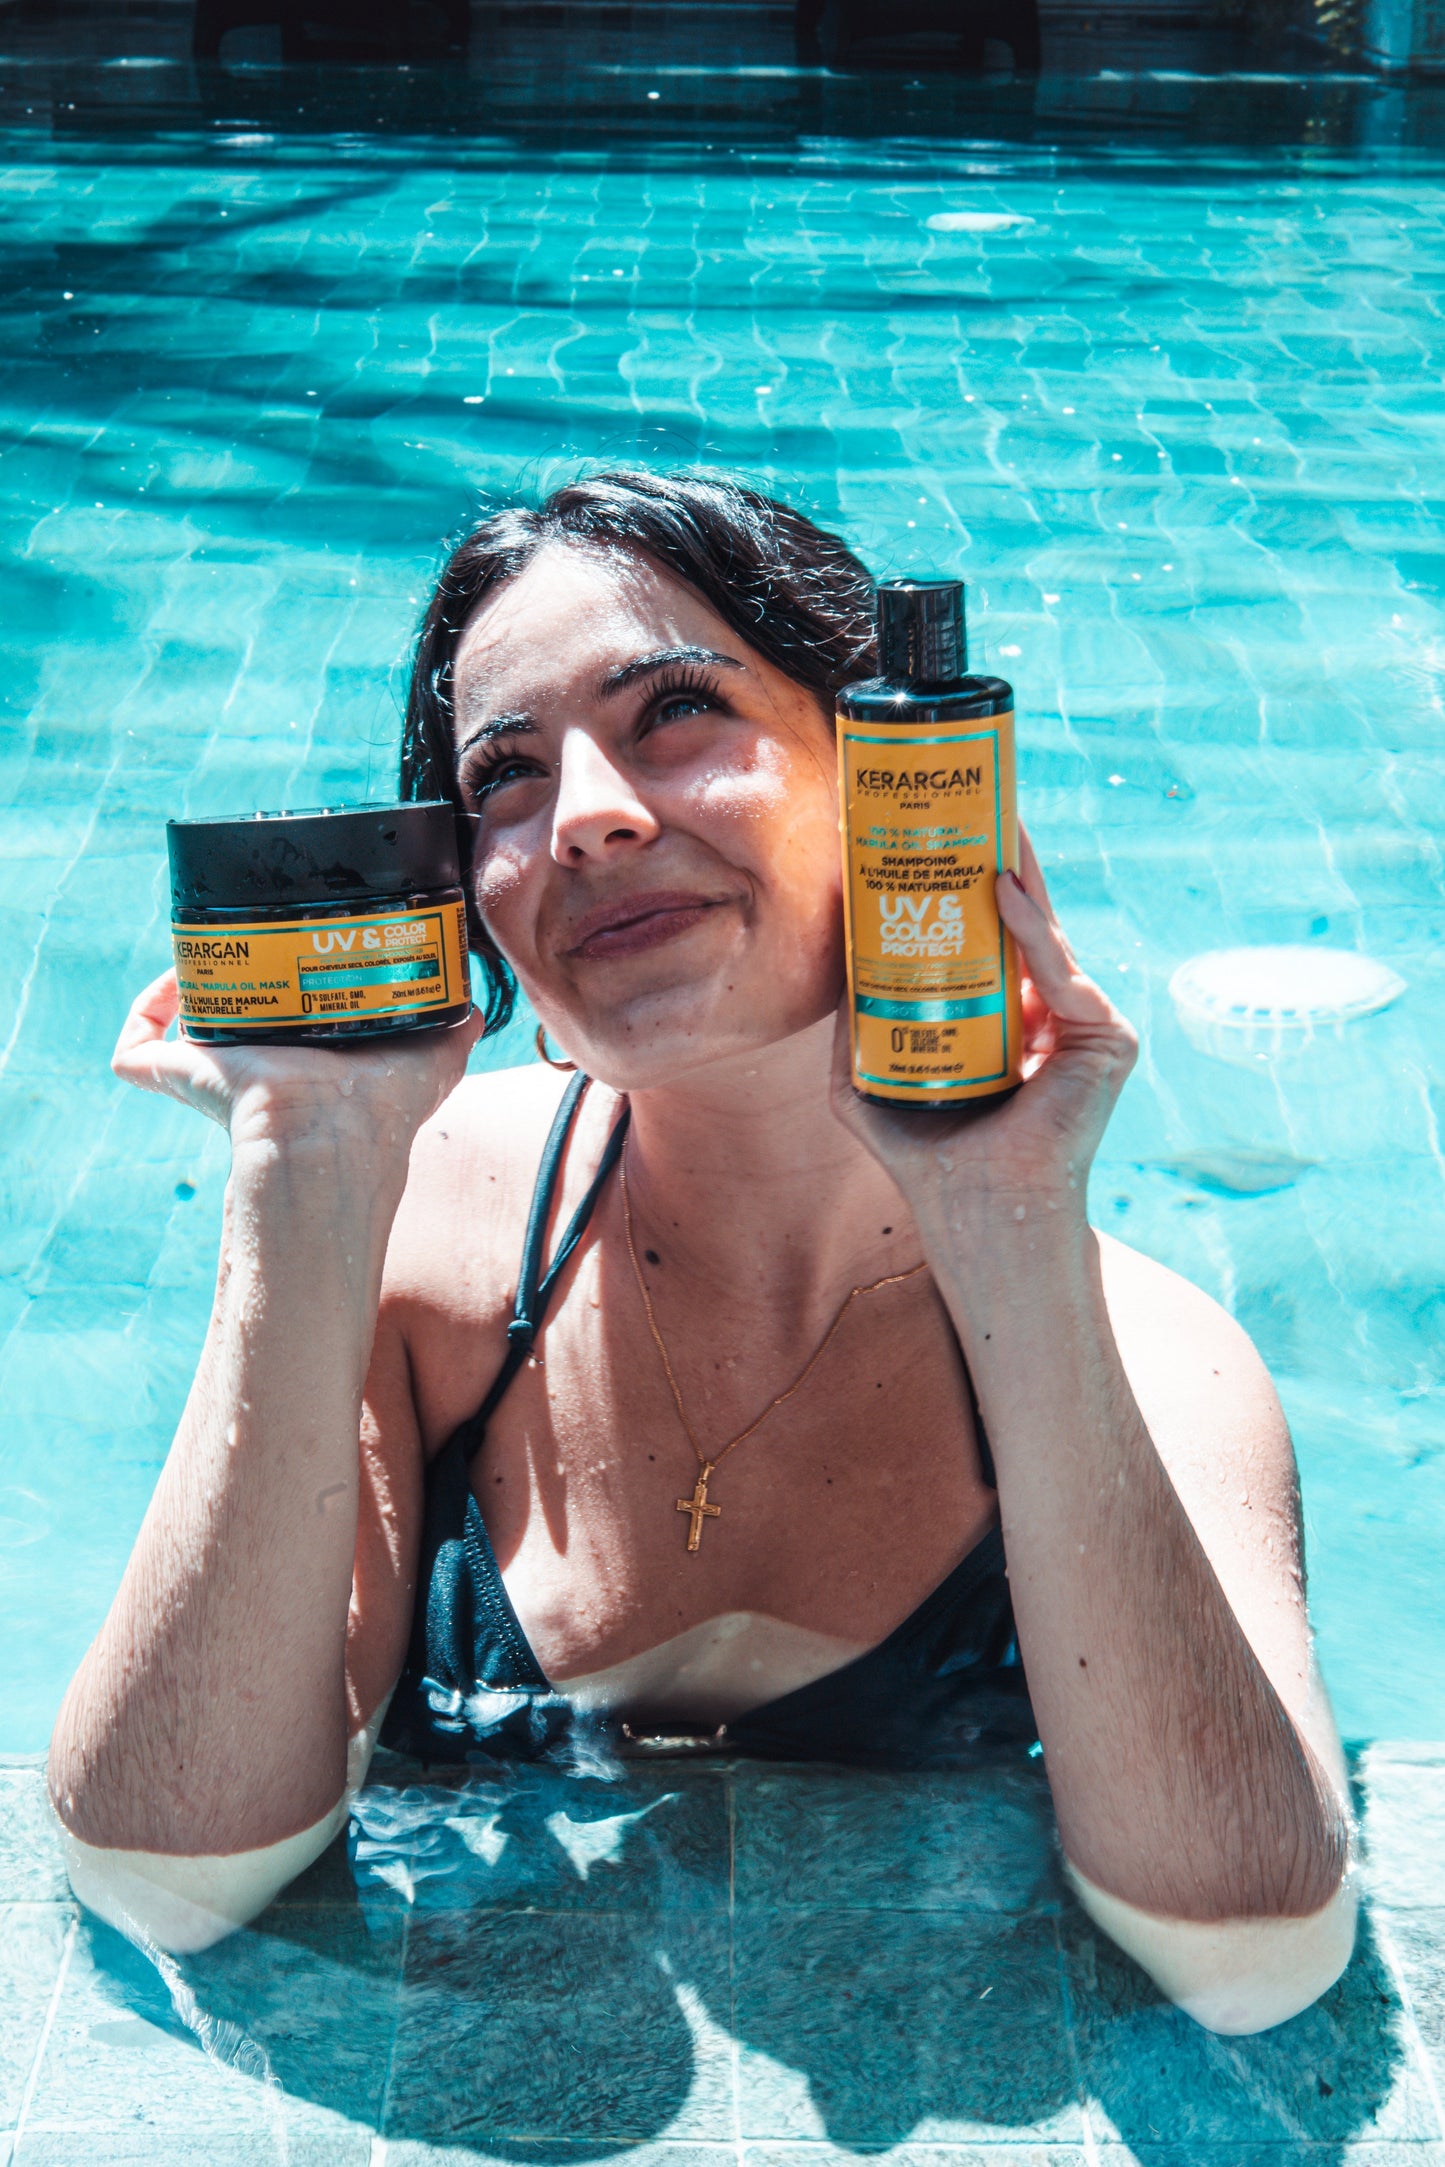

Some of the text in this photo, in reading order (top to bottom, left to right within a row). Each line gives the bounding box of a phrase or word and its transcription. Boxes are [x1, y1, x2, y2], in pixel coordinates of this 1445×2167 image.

[856, 766, 981, 791] KERARGAN
[857, 789, 982, 799] PROFESSIONNEL
[900, 802, 930, 810] PARIS
[902, 826, 962, 837] NATURAL
[901, 841, 922, 851] OIL
[881, 855, 957, 867] SHAMPOING
[868, 868, 909, 880] L'HUILE
[913, 869, 931, 880] DE
[934, 865, 984, 879] MARULA
[866, 879, 883, 891] 100
[885, 882, 895, 892] %
[878, 894, 963, 922] UV &
[879, 920, 965, 942] COLOR
[312, 922, 427, 954] UV & COLOR
[385, 934, 427, 947] PROTECT
[177, 941, 249, 959] KERARGAN
[881, 940, 965, 957] PROTECT
[197, 968, 214, 976] PARIS
[301, 965, 318, 973] POUR
[319, 963, 347, 971] CHEVEUX
[240, 982, 256, 991] OIL
[259, 980, 290, 989] MASK
[302, 974, 362, 986] PROTECTION
[221, 997, 233, 1006] DE
[235, 995, 279, 1006] MARULA
[320, 1000, 360, 1012] MINERAL OIL
[197, 1005, 243, 1015] NATURELLE
